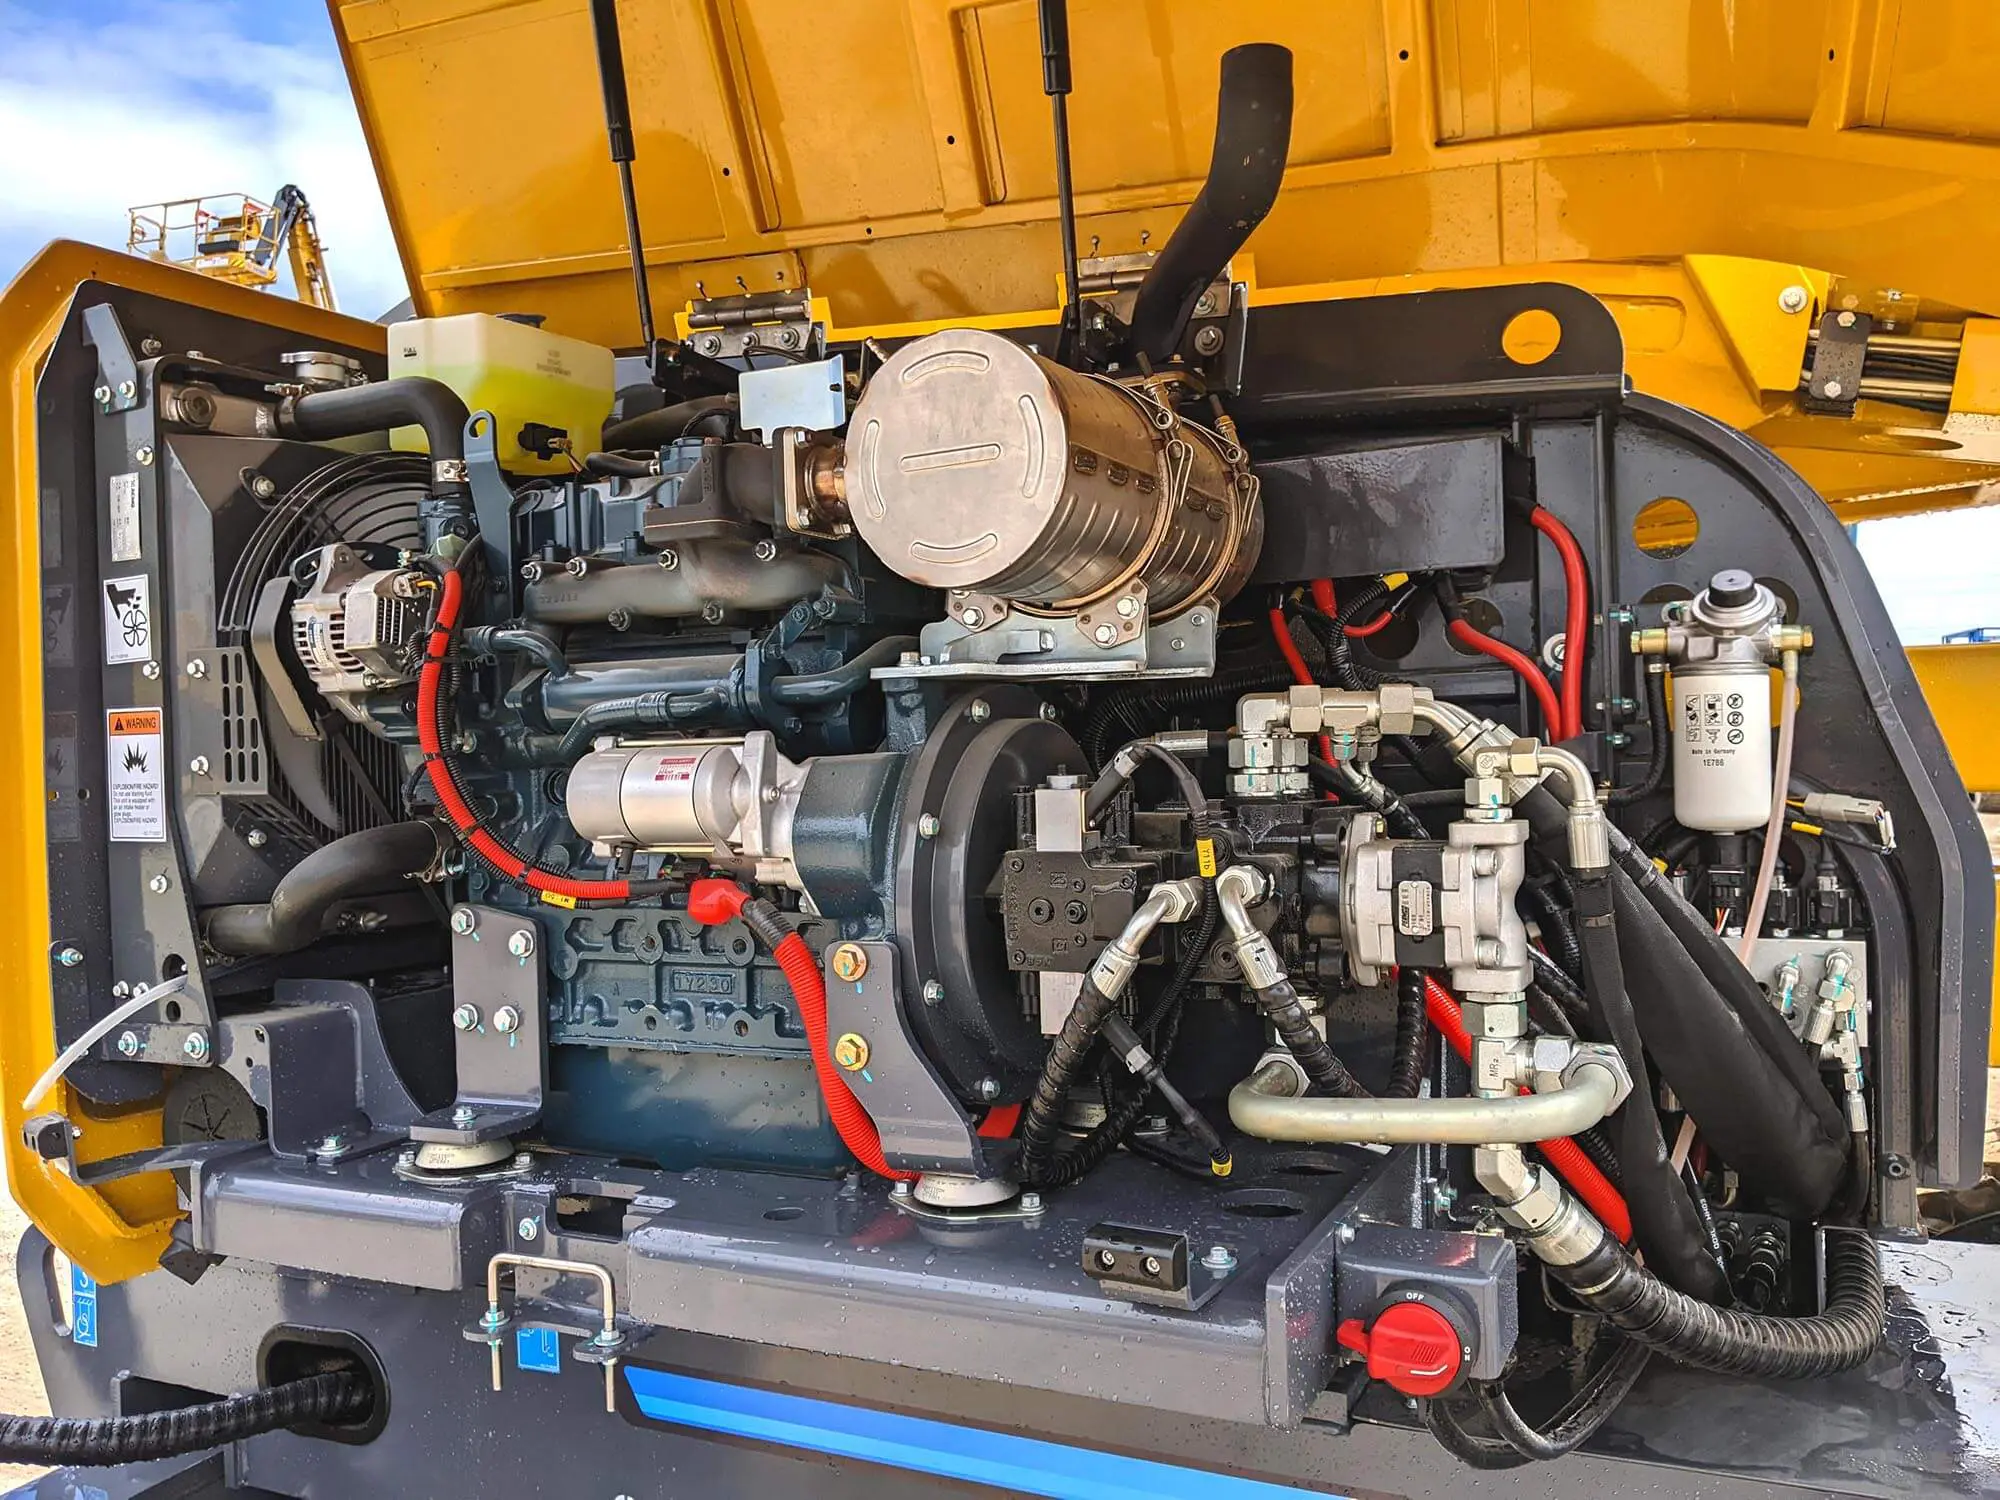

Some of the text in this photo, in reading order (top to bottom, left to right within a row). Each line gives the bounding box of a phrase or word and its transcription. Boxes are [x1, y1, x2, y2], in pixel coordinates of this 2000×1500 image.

[126, 717, 156, 729] WARNING
[1406, 1292, 1425, 1301] OFF
[1464, 1346, 1471, 1361] ON
